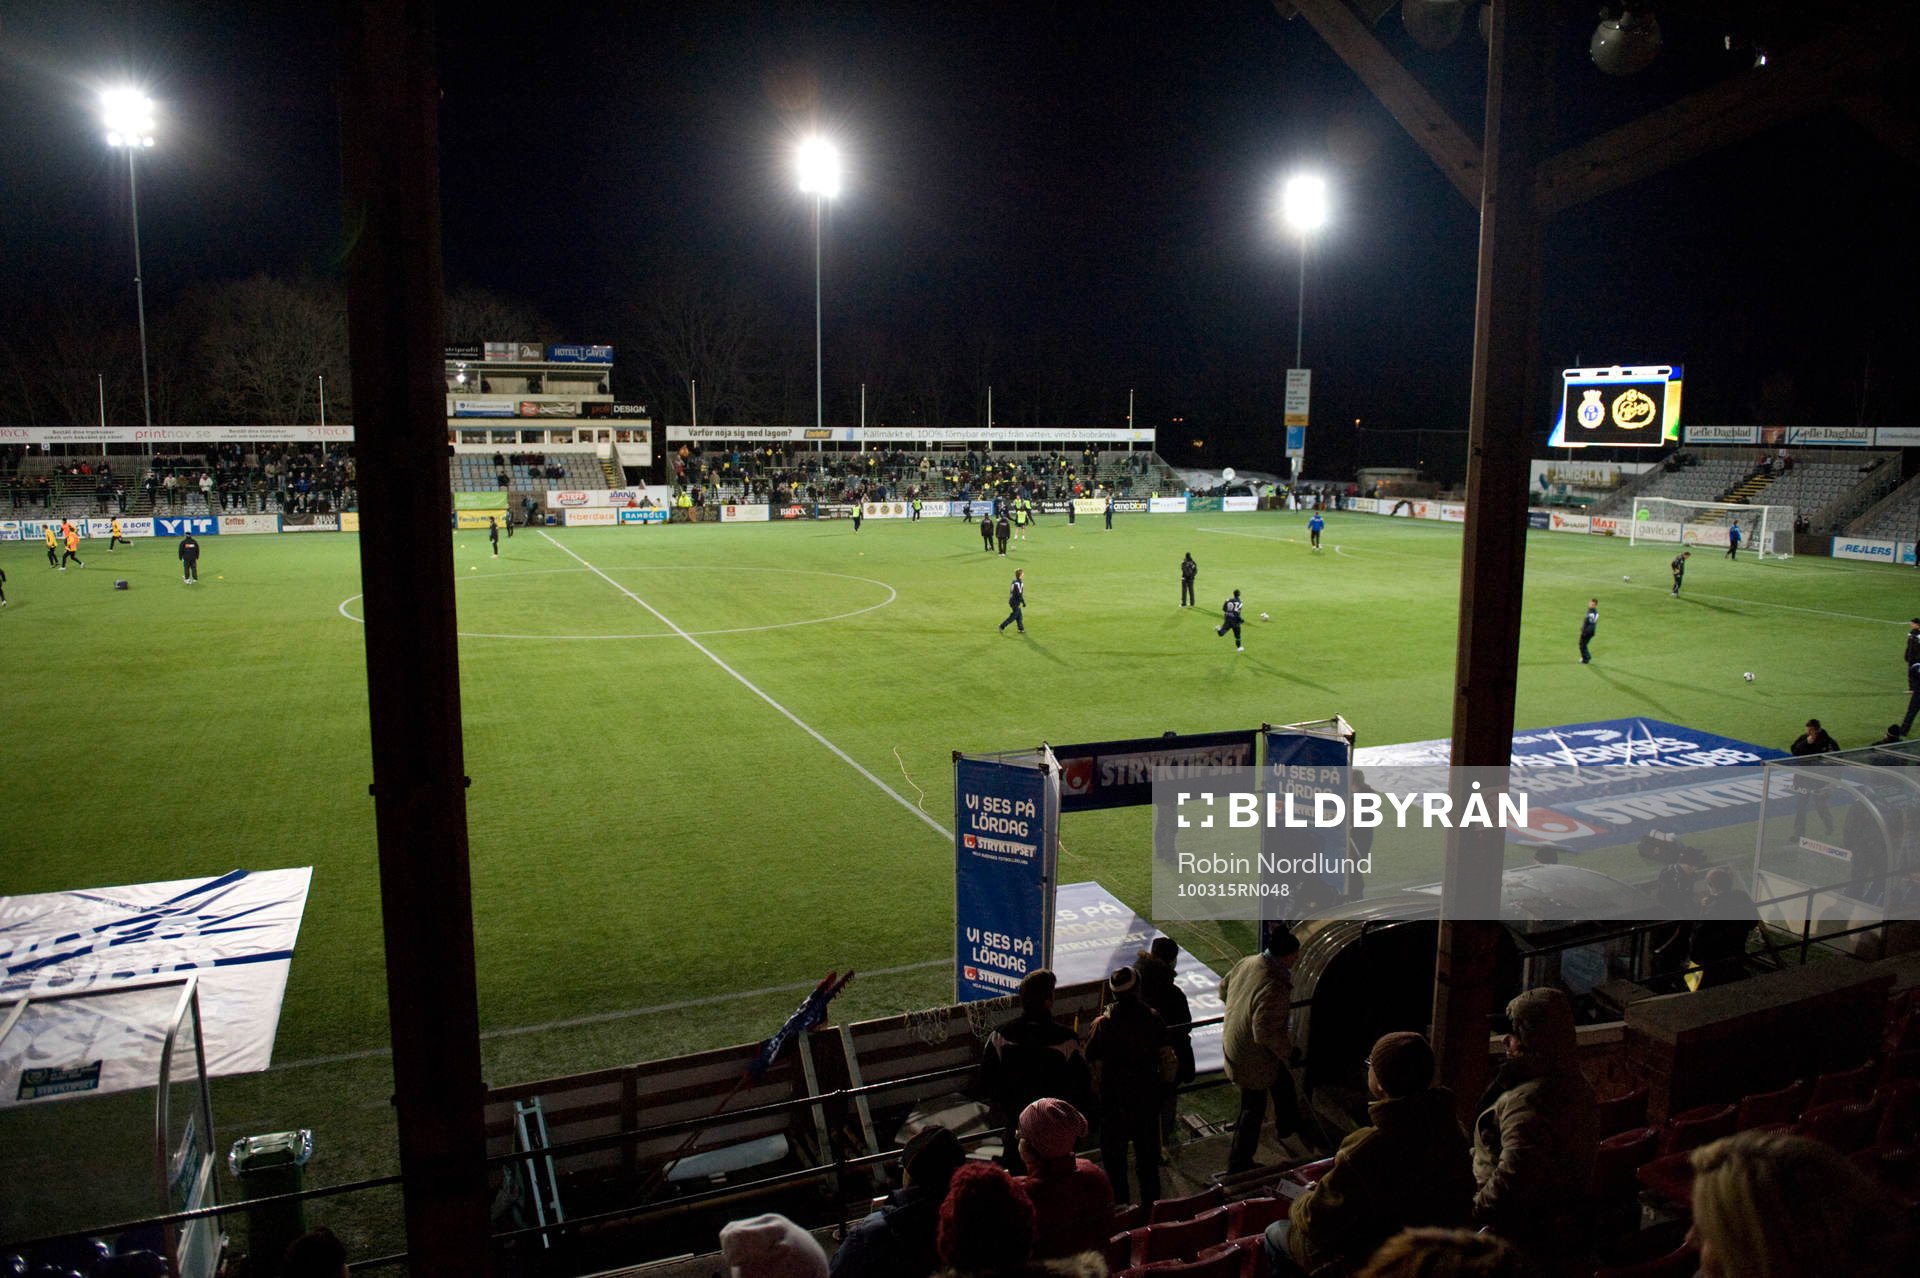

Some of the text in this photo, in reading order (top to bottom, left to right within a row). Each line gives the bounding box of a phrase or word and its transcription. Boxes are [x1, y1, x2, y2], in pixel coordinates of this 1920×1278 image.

[554, 348, 579, 357] HOTELL
[614, 405, 646, 414] DESIGN
[135, 429, 211, 441] printnov.se
[733, 429, 745, 439] sig
[746, 429, 763, 437] med
[764, 429, 792, 439] lagom?
[918, 430, 943, 438] 100%
[1690, 427, 1750, 438] Gefle Dagblad
[1824, 428, 1868, 440] Dagblad
[159, 519, 212, 534] YIT
[1562, 520, 1589, 530] SHARP
[1592, 517, 1617, 529] MAXI
[1844, 543, 1892, 556] REJLERS
[1100, 743, 1247, 788] STRYKTIPSET
[1273, 763, 1341, 785] VI SES PÅ
[965, 793, 1036, 818] VI SES PÅ
[971, 811, 1029, 838] LÖRDAG
[977, 837, 1037, 858] STRYKTIPSET
[1807, 840, 1849, 858] INTERSPORT
[1081, 901, 1122, 918] PÅ
[966, 926, 1034, 956] VI SES PÅ
[972, 945, 1027, 974] LÖRDAG
